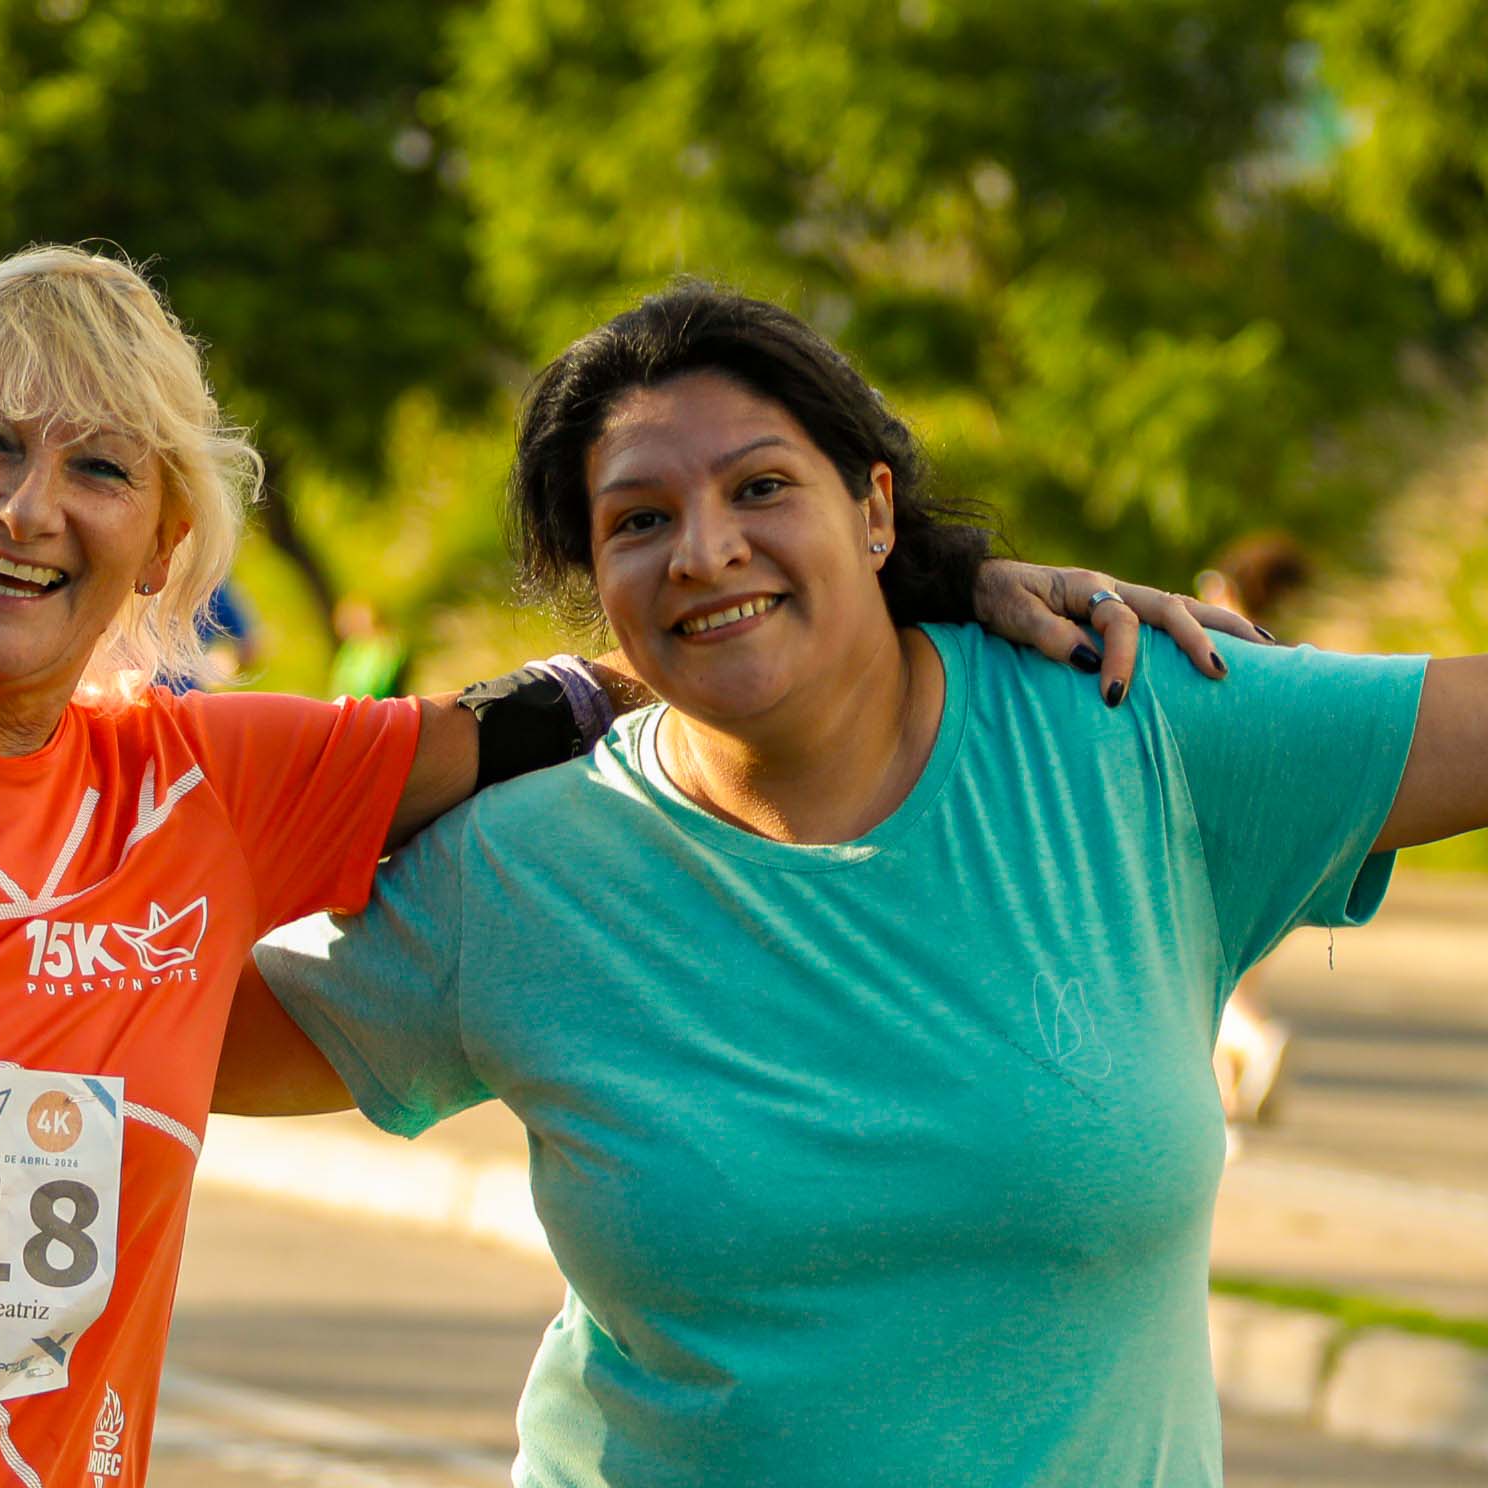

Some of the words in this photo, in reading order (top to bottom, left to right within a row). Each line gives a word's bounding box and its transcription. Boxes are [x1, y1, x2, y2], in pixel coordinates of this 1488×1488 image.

[25, 919, 127, 978] 15K
[36, 1109, 72, 1136] 4K
[4, 1155, 17, 1164] DE
[20, 1156, 50, 1166] ABRIL
[54, 1158, 79, 1169] 2026
